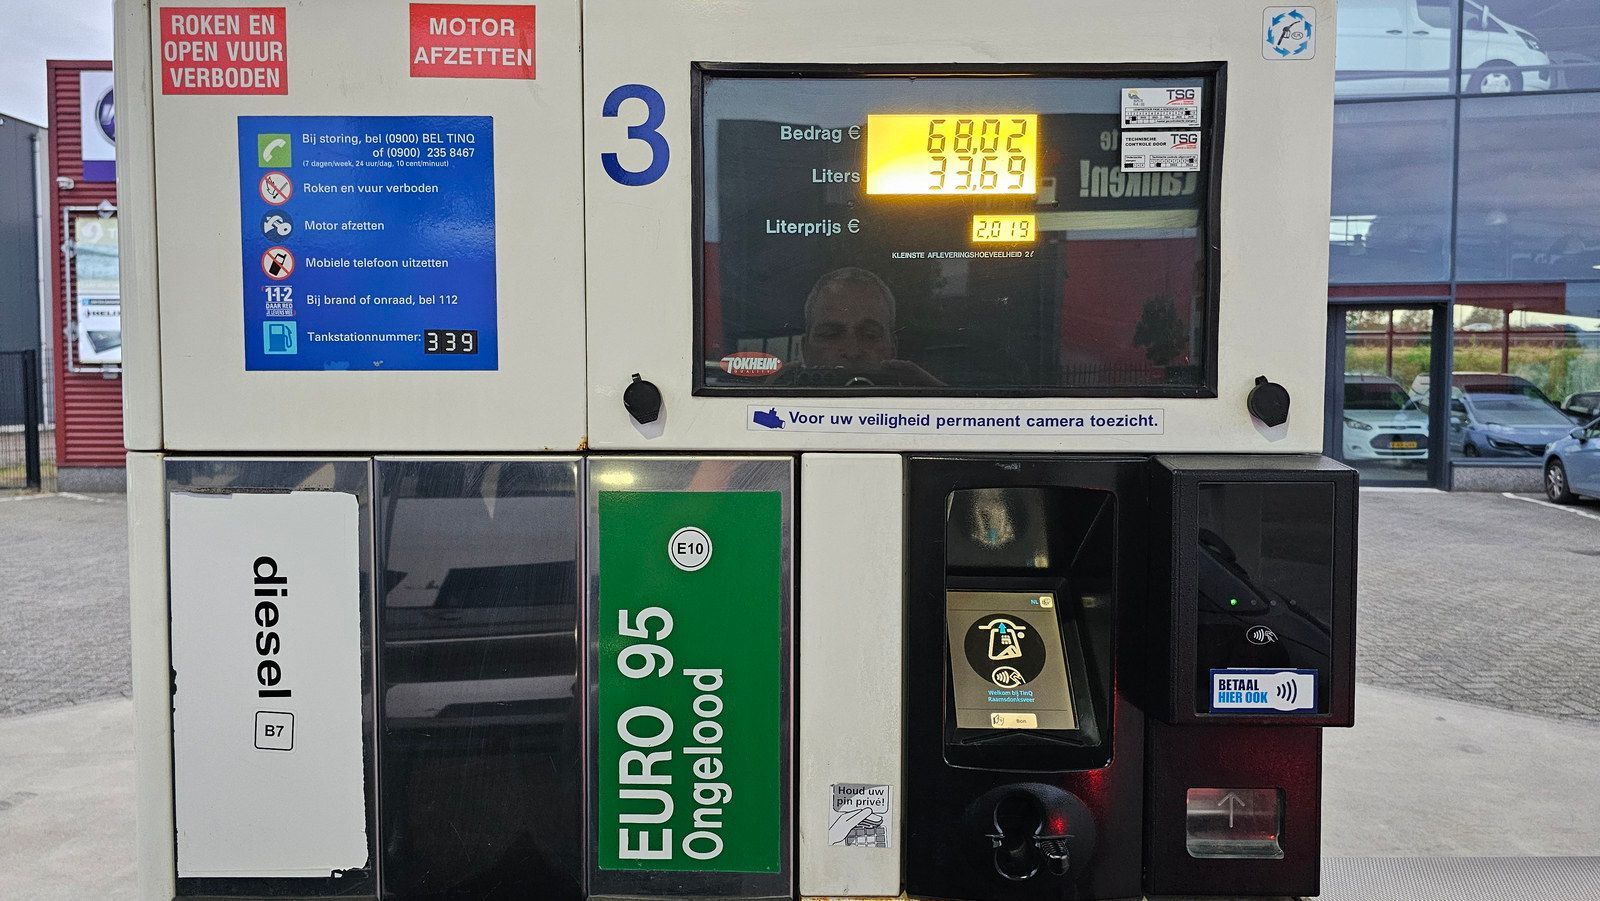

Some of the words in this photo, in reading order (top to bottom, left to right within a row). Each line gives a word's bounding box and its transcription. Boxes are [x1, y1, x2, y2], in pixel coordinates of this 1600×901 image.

[171, 14, 240, 35] ROKEN
[249, 14, 275, 35] EN
[429, 17, 515, 37] MOTOR
[164, 41, 218, 62] OPEN
[226, 41, 283, 62] VUUR
[413, 46, 532, 66] AFZETTEN
[170, 67, 280, 88] VERBODEN
[1166, 89, 1195, 100] TSG
[302, 133, 316, 145] Bij
[319, 134, 362, 145] storing,
[365, 134, 382, 144] bel
[385, 133, 419, 145] (0900)
[422, 134, 443, 144] BEL
[446, 134, 475, 144] TINQ
[600, 84, 670, 187] 3
[780, 125, 842, 143] Bedrag
[848, 125, 861, 140] €
[927, 119, 1027, 154] 68,02
[1170, 133, 1198, 144] TSG
[372, 148, 384, 158] of
[387, 148, 421, 158] (0900)
[427, 148, 446, 158] 235
[449, 148, 475, 158] 8467
[405, 160, 449, 168] cent/minuut)
[928, 156, 1026, 190] 33,69
[812, 168, 861, 184] Liters
[303, 183, 338, 193] Roken
[341, 185, 355, 193] en
[358, 185, 383, 193] vuur
[386, 183, 439, 193] verboden
[304, 220, 338, 231] Motor
[341, 220, 385, 231] afzetten
[766, 219, 842, 237] Literprijs
[848, 218, 861, 234] €
[976, 220, 1030, 239] 2,019
[305, 257, 350, 268] Mobiele
[353, 257, 399, 268] telefoon
[402, 257, 449, 268] uitzetten
[891, 251, 924, 259] KLEINSTE
[927, 251, 1022, 259] AFLEVERINGSHOEVEELHEID
[306, 294, 321, 306] Bij
[324, 294, 356, 305] brand
[359, 294, 371, 305] of
[373, 295, 416, 306] onraad,
[418, 295, 436, 305] bel
[439, 295, 458, 305] 112
[307, 331, 421, 342] Tankstationnummer:
[427, 332, 473, 352] 339
[721, 356, 778, 374] TOKHEIM
[789, 411, 825, 425] Voor
[830, 415, 853, 425] uw
[858, 413, 930, 429] veiligheid
[936, 415, 1021, 429] permanent
[1026, 416, 1084, 427] camera
[1090, 414, 1158, 427] toezicht.
[677, 542, 704, 555] E10
[253, 556, 292, 698] diesel
[617, 606, 674, 679] 95
[1218, 679, 1260, 691] BETAAL
[1218, 691, 1243, 703] HIER
[1245, 691, 1268, 703] OOK
[264, 724, 285, 738] B7
[682, 668, 732, 860] Ongelood
[617, 705, 674, 860] EURO
[838, 786, 865, 795] Houd
[868, 788, 884, 796] uw
[836, 797, 853, 807] pin
